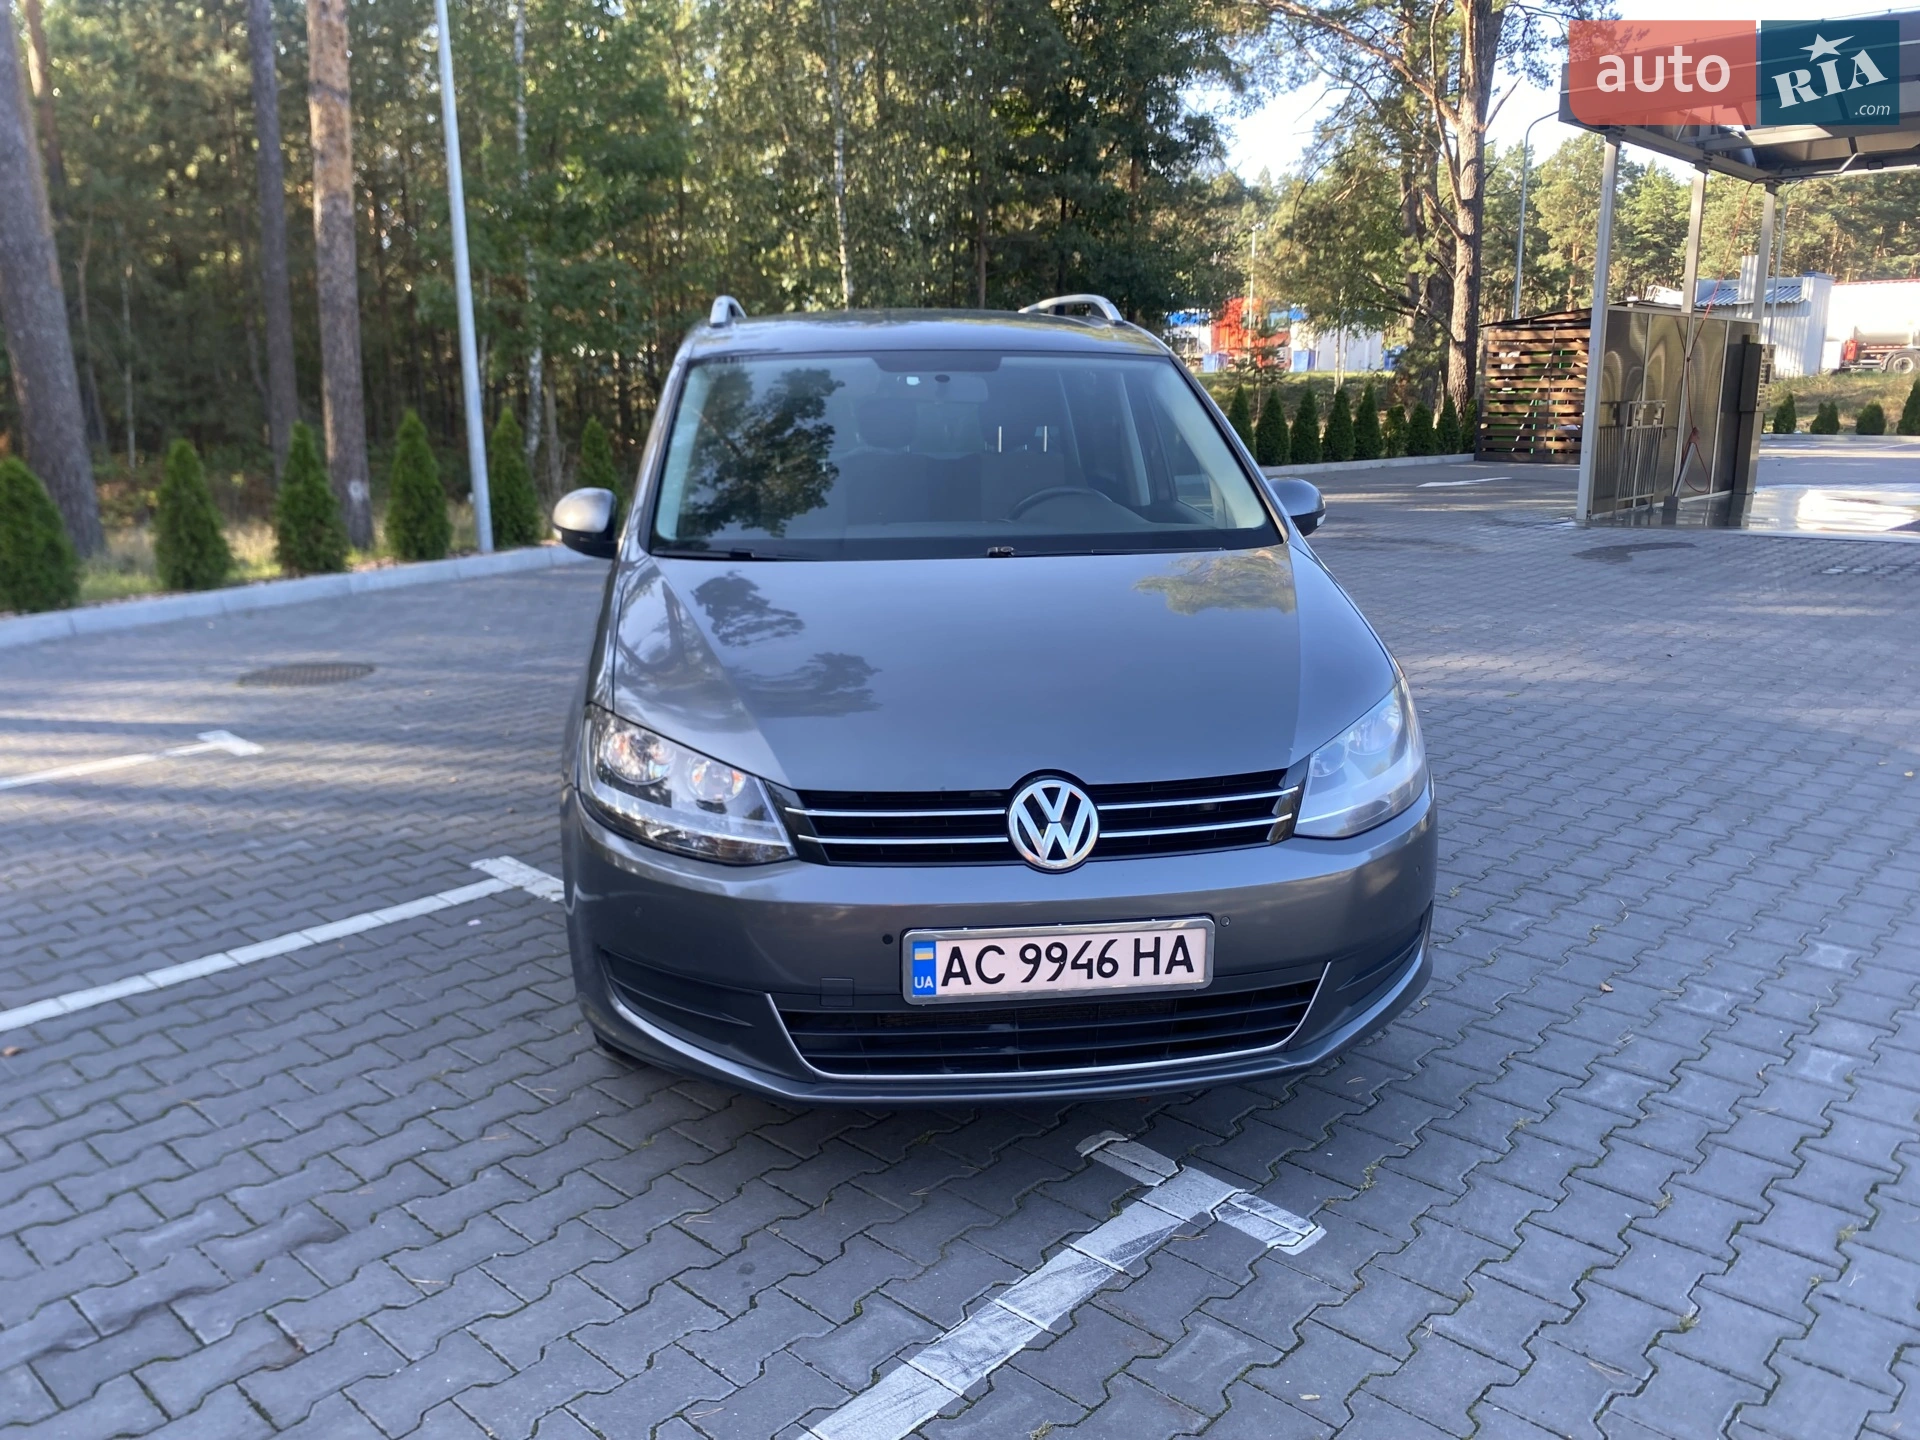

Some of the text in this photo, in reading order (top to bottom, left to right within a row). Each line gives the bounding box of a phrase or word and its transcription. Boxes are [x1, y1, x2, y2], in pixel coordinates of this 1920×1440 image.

[1012, 781, 1095, 867] VW
[914, 976, 934, 989] UA
[941, 934, 1194, 987] AC 9946 HA
